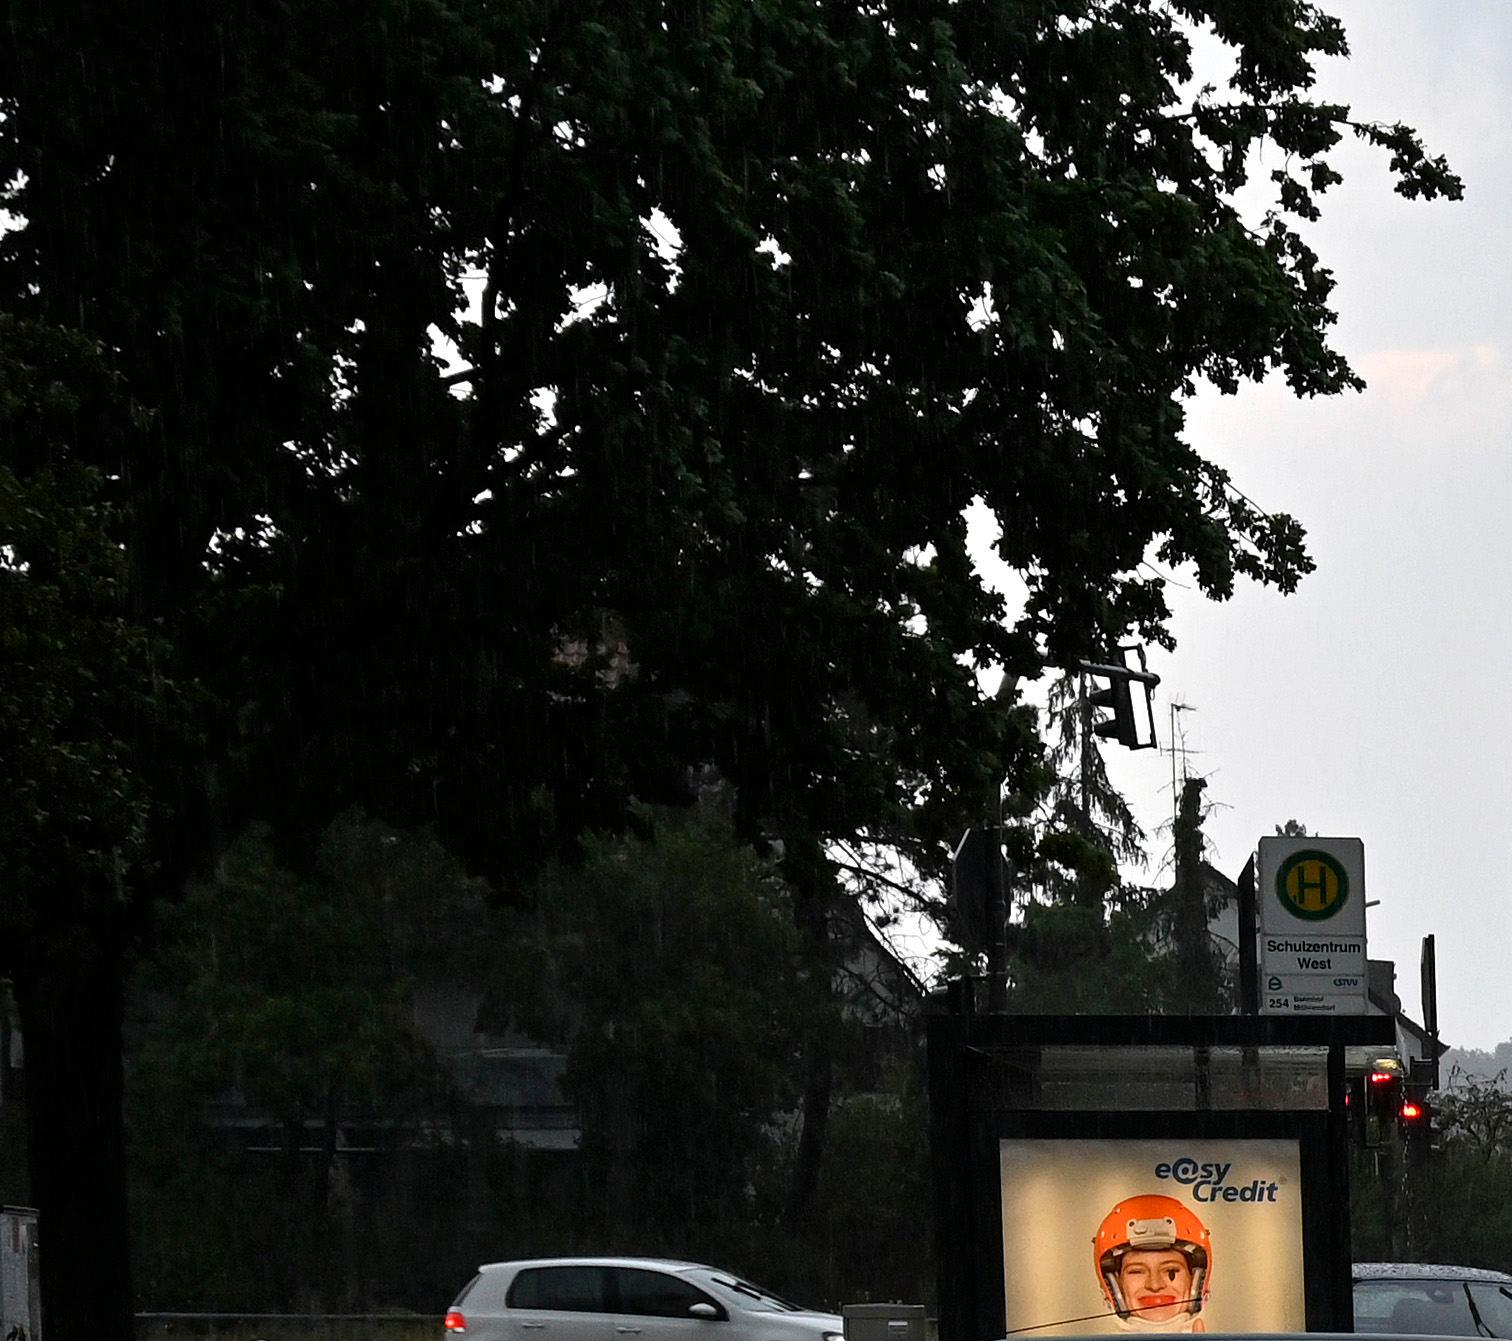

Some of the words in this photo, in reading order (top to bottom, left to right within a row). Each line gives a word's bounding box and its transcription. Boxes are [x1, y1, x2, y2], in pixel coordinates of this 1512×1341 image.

[1298, 865, 1327, 905] H
[1267, 940, 1361, 953] Schulzentrum
[1297, 957, 1332, 970] West
[1269, 998, 1290, 1008] 254
[1155, 1158, 1231, 1186] e@sy
[1192, 1180, 1278, 1202] Credit
